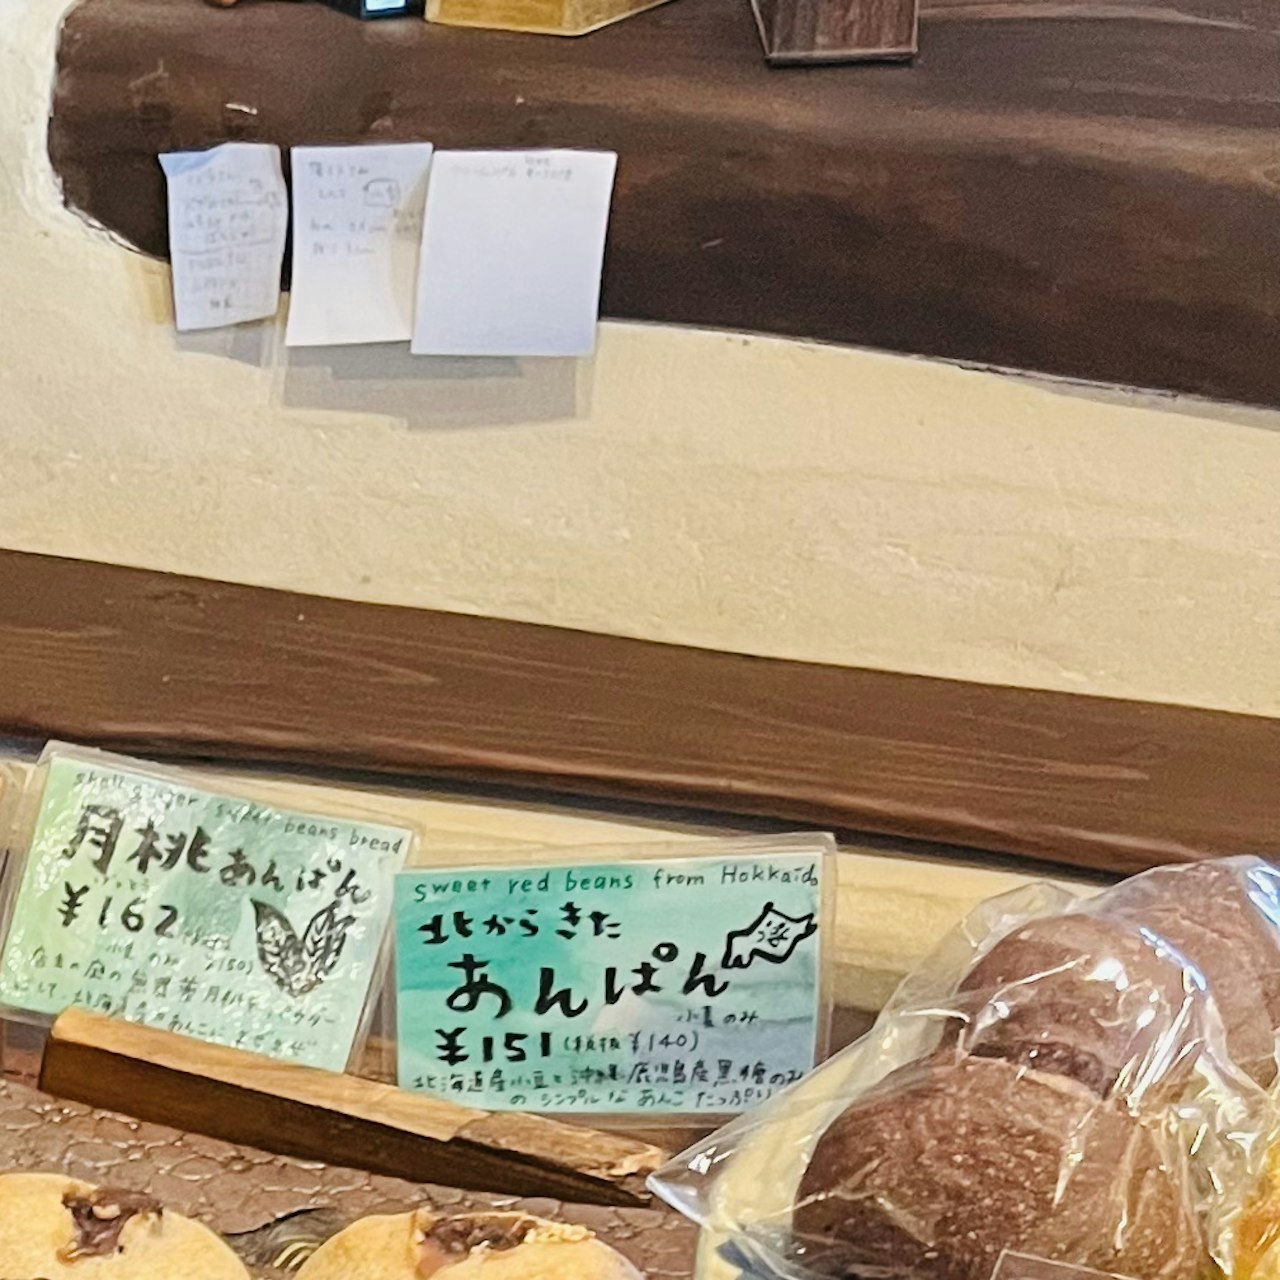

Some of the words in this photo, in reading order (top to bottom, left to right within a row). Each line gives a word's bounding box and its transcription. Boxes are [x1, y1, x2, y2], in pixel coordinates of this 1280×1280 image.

[62, 803, 374, 904] 月桃あんぱん
[348, 829, 403, 854] bread
[56, 880, 179, 938] ¥162
[412, 878, 491, 903] sweet
[508, 872, 550, 895] red
[564, 872, 634, 892] beans
[653, 869, 705, 888] from
[446, 942, 730, 1020] あんぱん
[435, 1027, 552, 1066] ¥151
